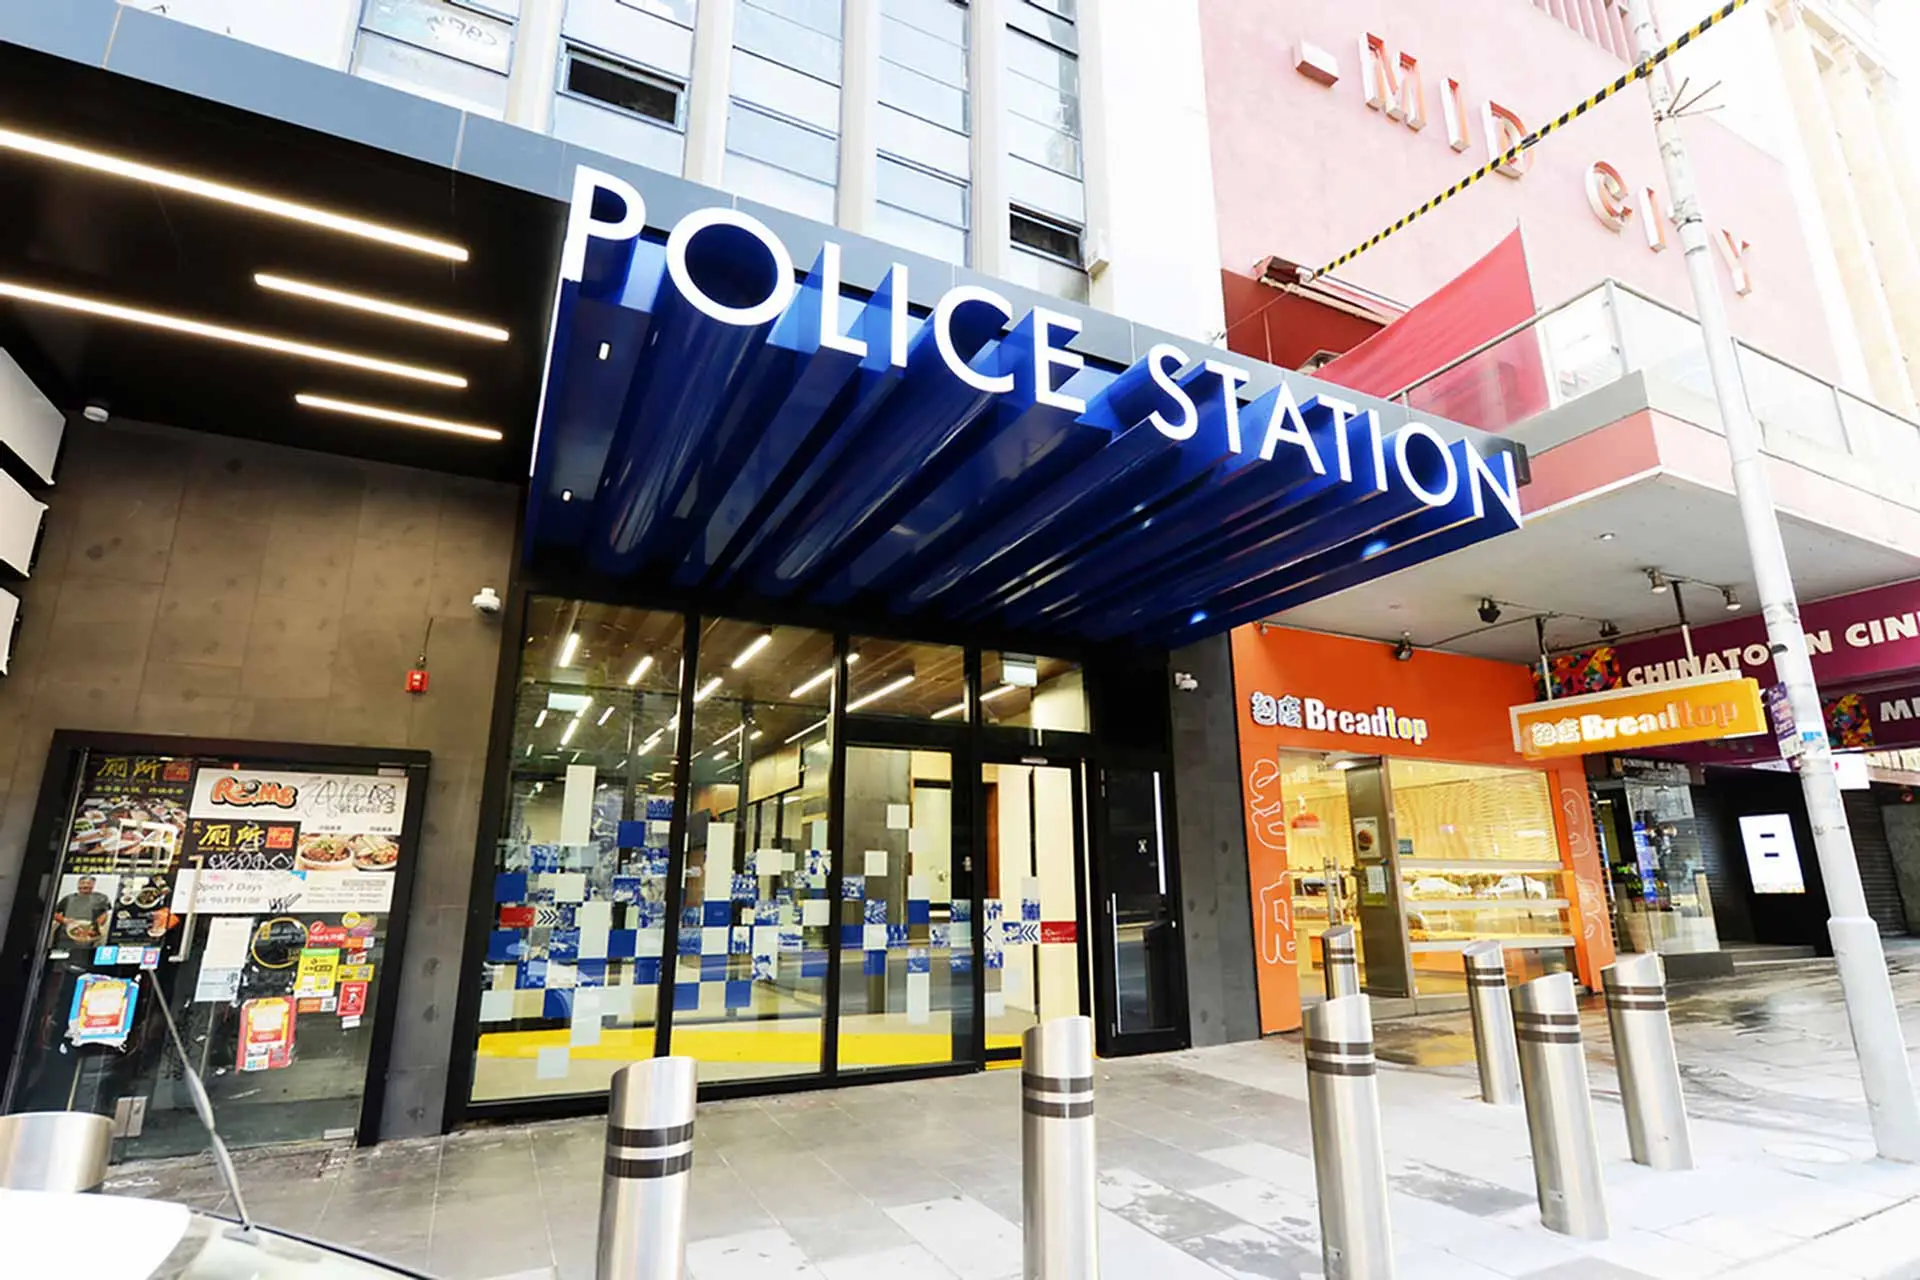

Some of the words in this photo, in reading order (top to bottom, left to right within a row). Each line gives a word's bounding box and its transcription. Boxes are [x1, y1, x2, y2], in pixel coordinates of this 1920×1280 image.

[1359, 31, 1535, 180] MID
[1586, 159, 1752, 298] CIY
[563, 164, 1087, 414] POLICE
[1147, 343, 1523, 530] STATION
[1627, 630, 1833, 687] CHINATON
[1844, 611, 1920, 647] CIN
[1304, 697, 1428, 745] Breadtop
[1579, 700, 1738, 742] Breadtop
